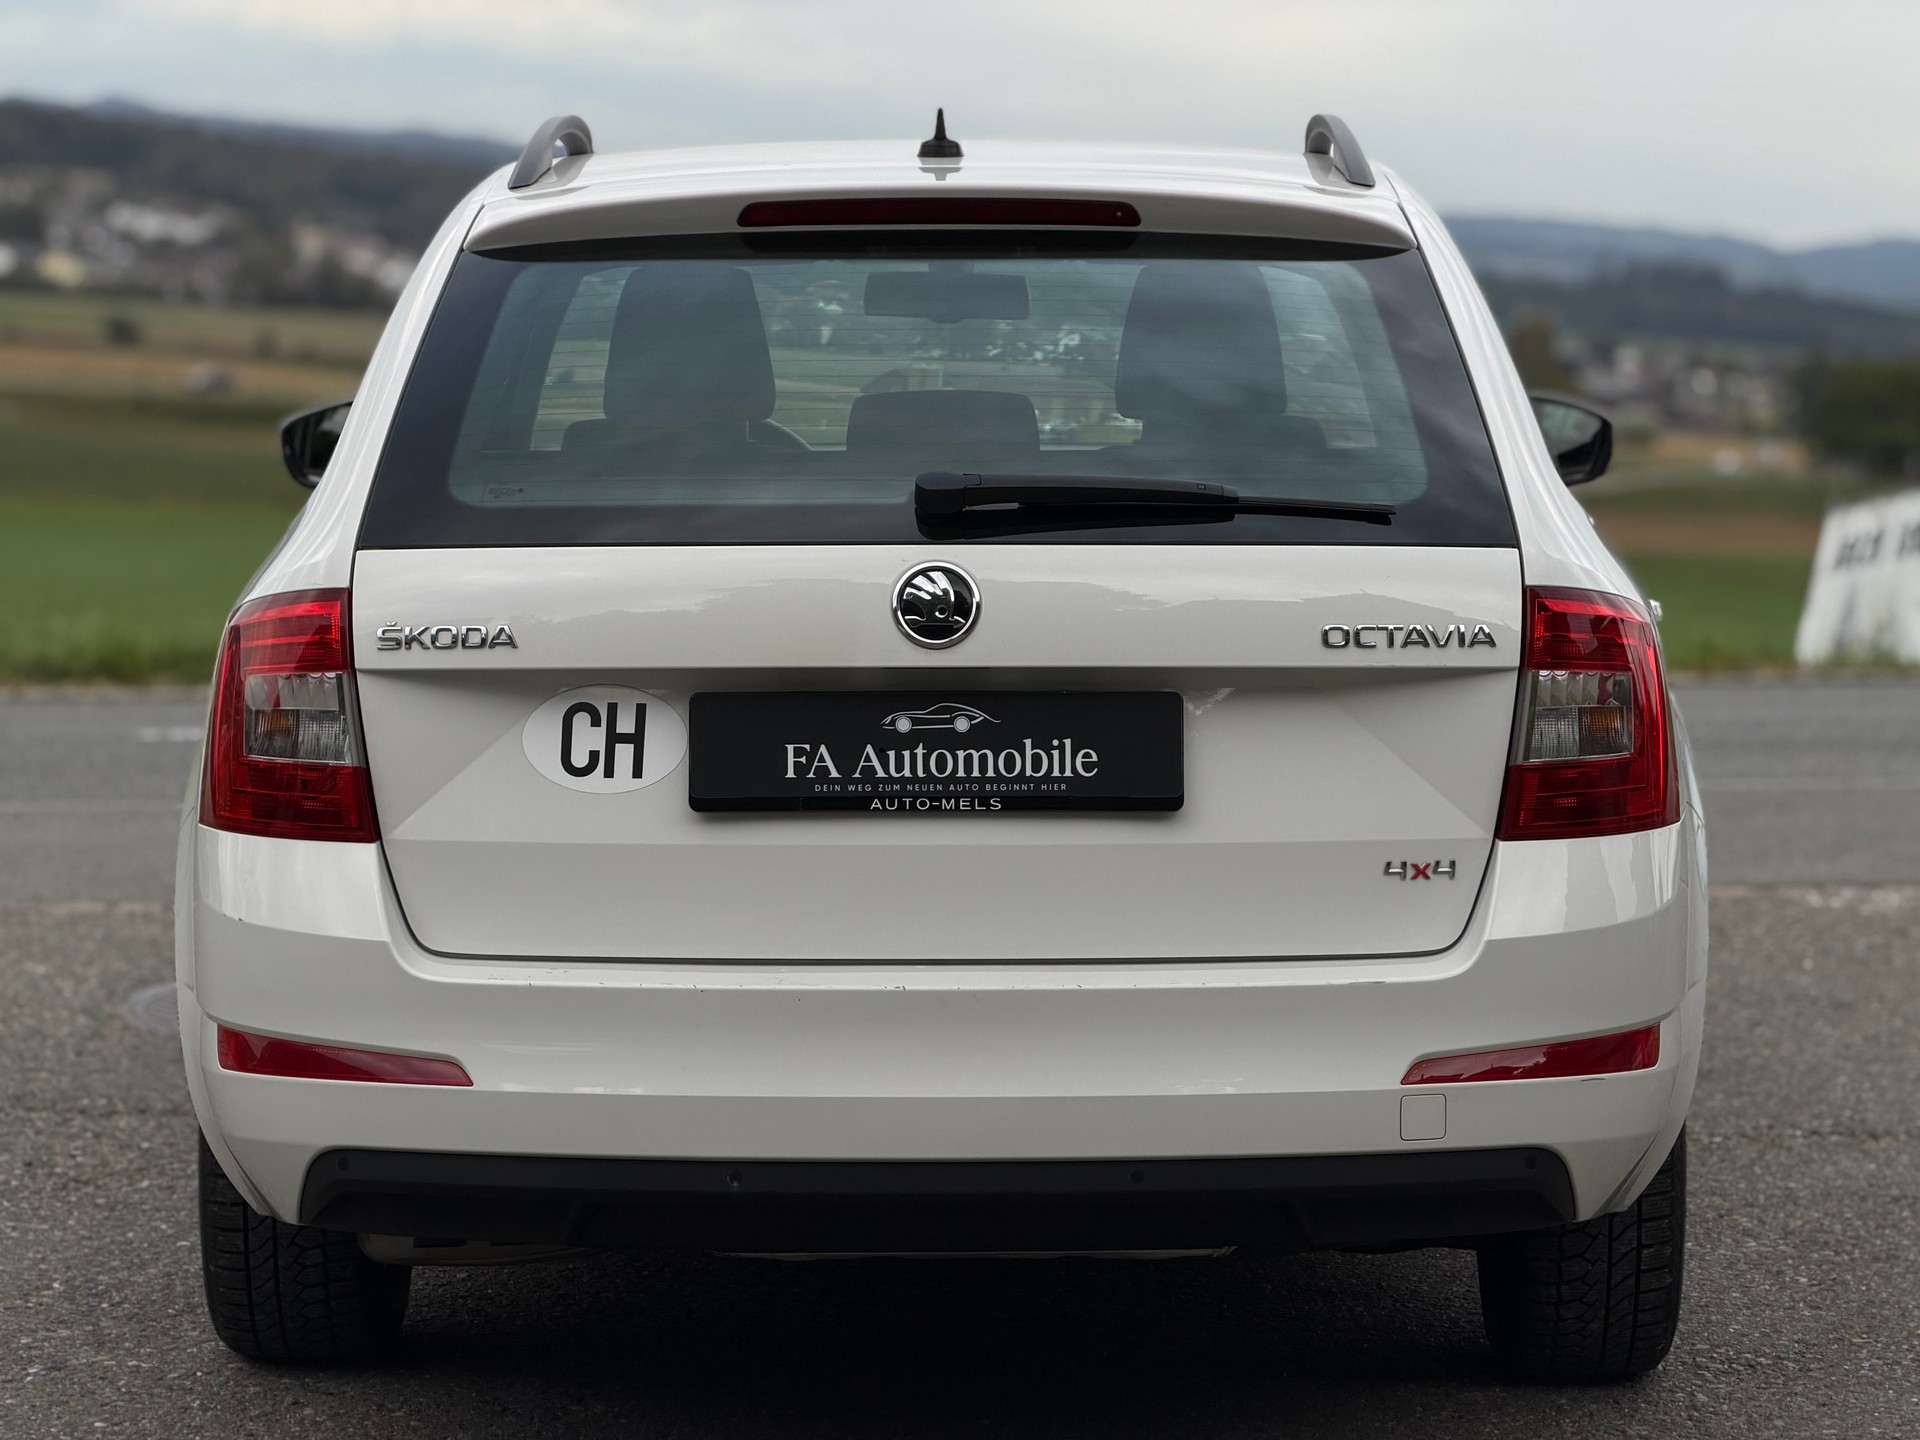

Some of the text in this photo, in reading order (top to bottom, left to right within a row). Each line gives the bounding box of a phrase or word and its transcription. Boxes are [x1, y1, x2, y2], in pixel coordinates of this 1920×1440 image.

[376, 621, 518, 650] ŠKODA
[1321, 624, 1497, 649] OCTAVIA
[560, 701, 648, 779] CH
[784, 737, 1099, 778] FA Automobile
[814, 784, 841, 792] DEIN
[847, 784, 872, 792] WEG
[948, 783, 979, 791] AUTO
[985, 783, 1035, 791] BEGINNT
[1041, 783, 1067, 791] HIER
[869, 798, 1002, 810] AUTO-MELS
[1383, 859, 1456, 881] 4x4
